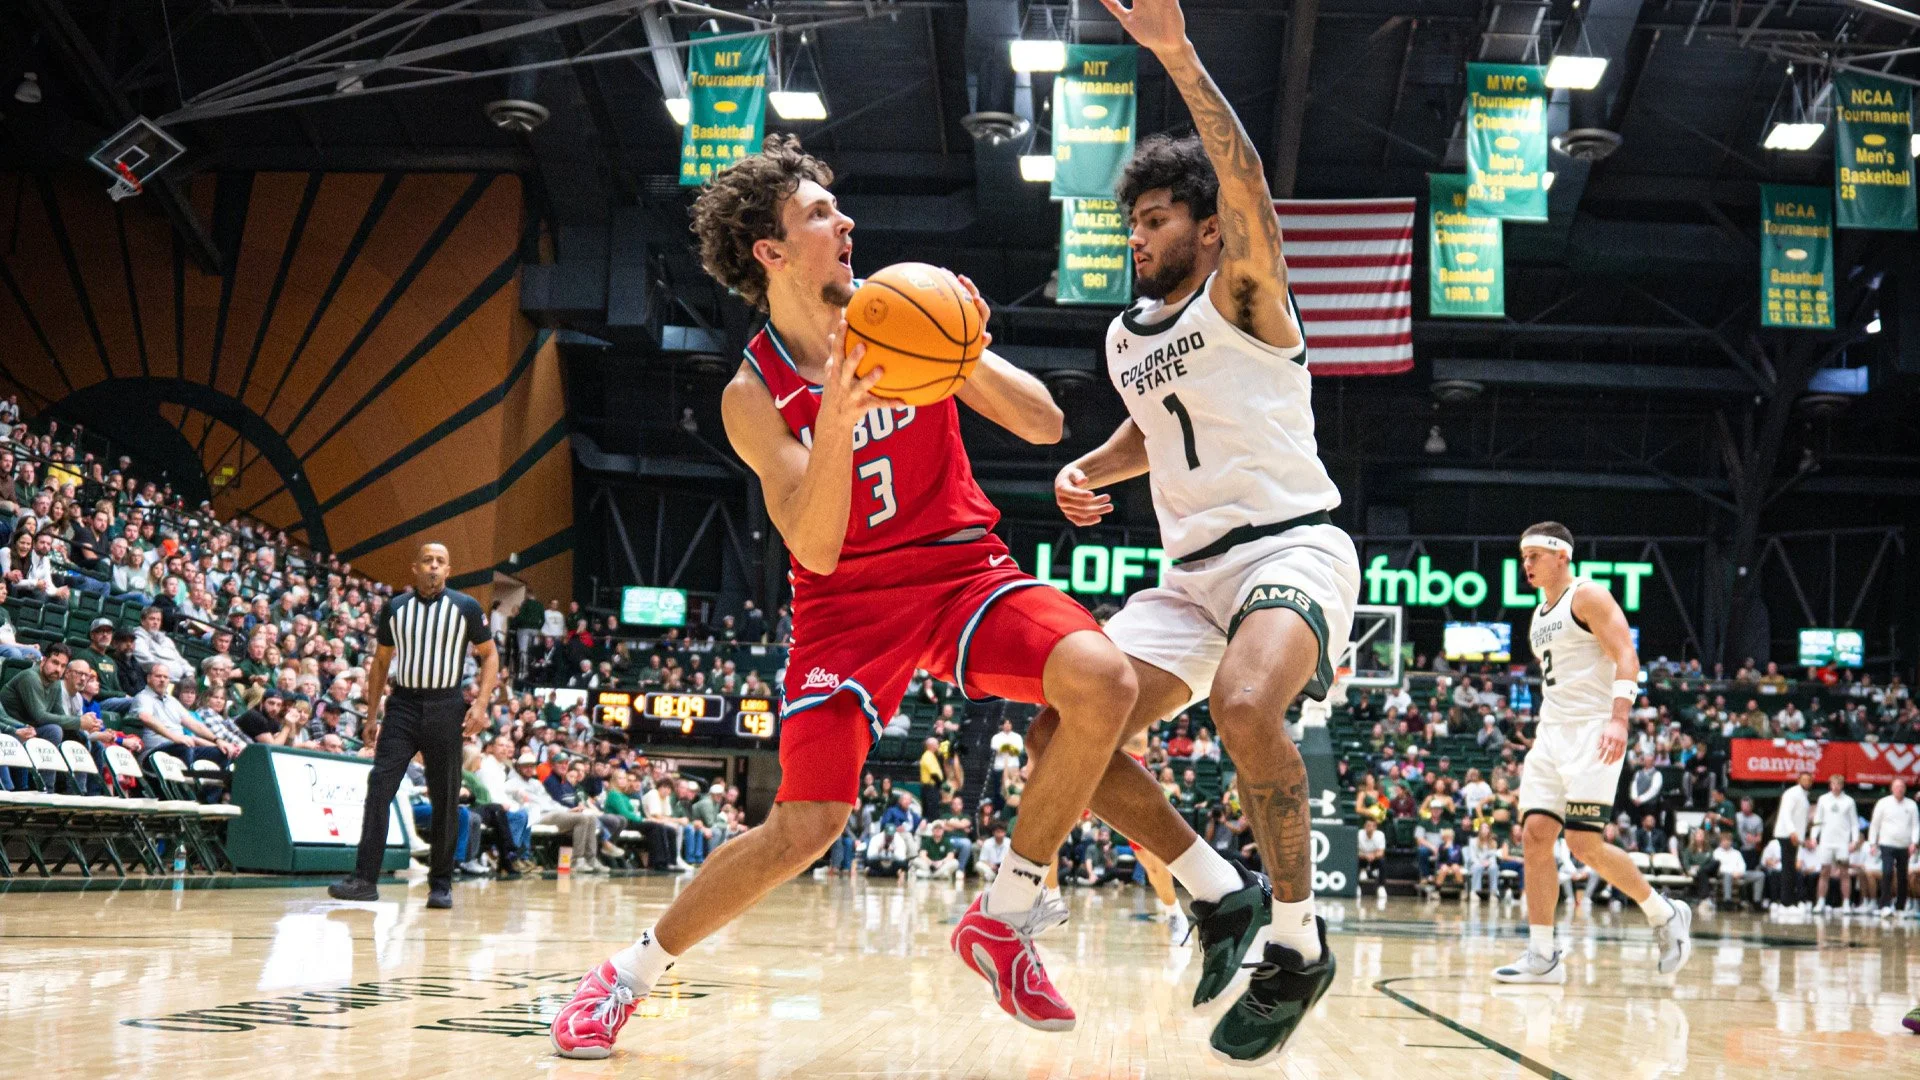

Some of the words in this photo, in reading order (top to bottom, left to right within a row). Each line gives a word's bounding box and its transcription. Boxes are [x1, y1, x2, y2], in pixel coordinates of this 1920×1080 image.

[715, 52, 741, 67] NIT
[1083, 61, 1108, 76] NIT
[691, 72, 765, 87] Tournament
[1486, 75, 1527, 91] MWC
[1852, 89, 1893, 106] NCAA
[1836, 105, 1910, 125] Tournament
[691, 124, 754, 140] Basketball
[1489, 154, 1524, 171] Men's
[1856, 147, 1895, 165] Men's
[1477, 170, 1538, 188] Basketball
[1840, 167, 1910, 186] Basketball
[1841, 184, 1856, 200] 25
[1775, 202, 1816, 218] NCAA
[1072, 212, 1121, 228] ATHLETIC
[1763, 219, 1830, 238] Tournament
[1065, 230, 1127, 246] Conference
[1066, 254, 1123, 269] Basketball
[1083, 273, 1107, 288] 1961
[1440, 267, 1494, 283] Basketball
[1770, 268, 1824, 287] Basketball
[1120, 331, 1205, 388] COLORADO
[1135, 359, 1187, 396] STATE
[1162, 392, 1201, 471] 1
[858, 455, 897, 529] 3
[1036, 543, 1180, 596] LOFT
[1365, 554, 1488, 608] fnbo
[1501, 558, 1654, 612] LFT
[1535, 632, 1553, 648] STATE
[1543, 648, 1557, 687] 2
[800, 666, 840, 690] Lobos
[653, 694, 705, 719] 18:09
[743, 713, 772, 737] 43
[1746, 756, 1816, 774] canvas
